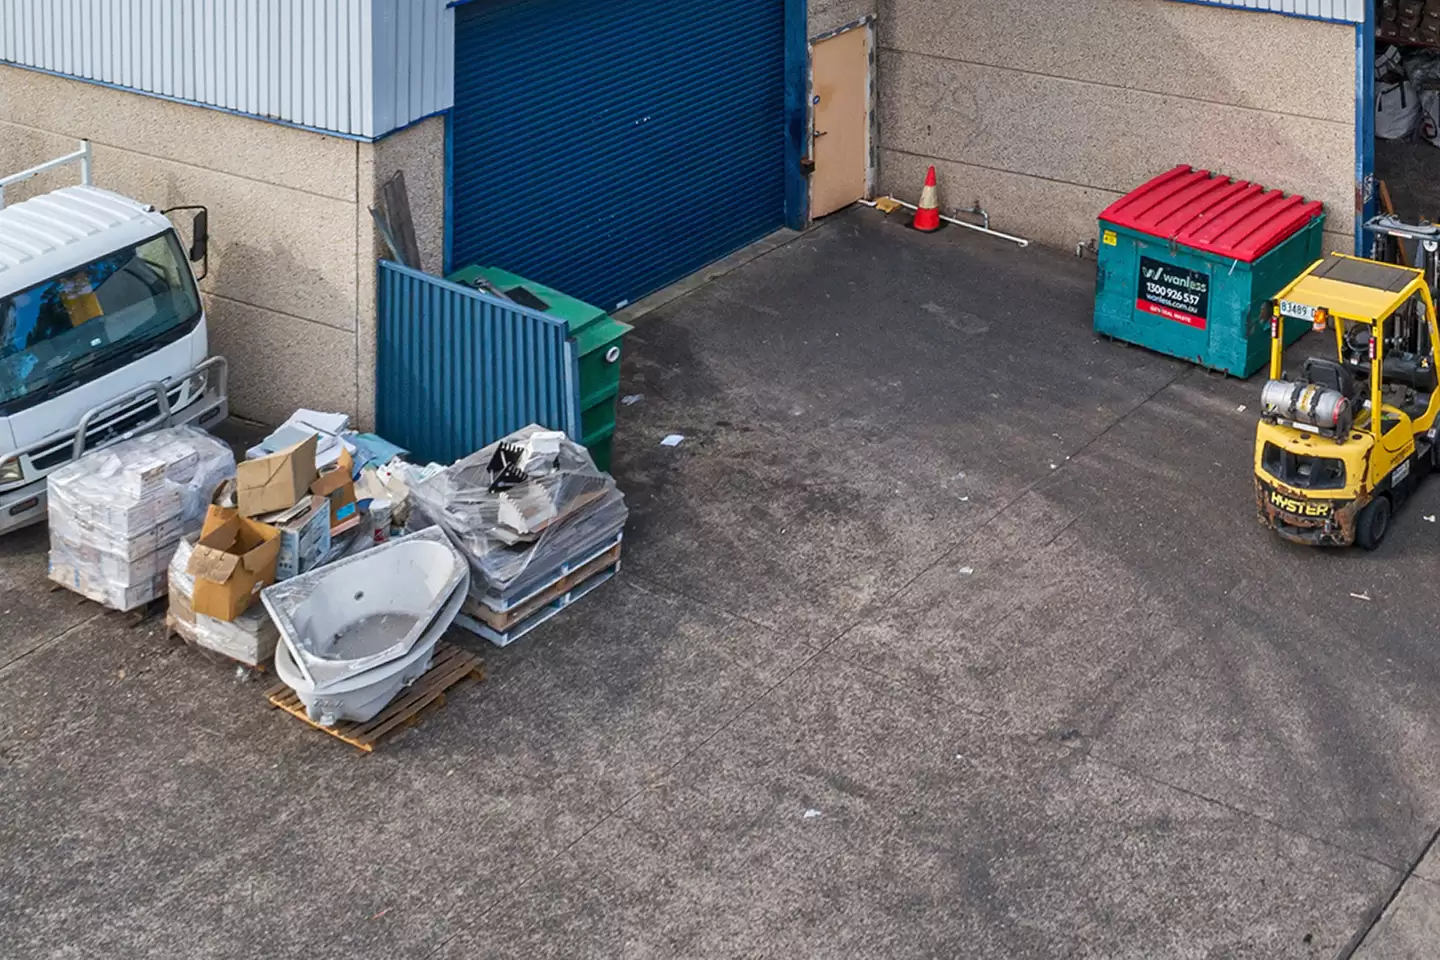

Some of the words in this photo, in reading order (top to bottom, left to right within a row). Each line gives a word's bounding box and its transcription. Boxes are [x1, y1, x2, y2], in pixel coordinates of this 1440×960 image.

[1146, 281, 1166, 296] 1300
[1166, 288, 1183, 301] 926
[1163, 273, 1207, 293] wanless
[1271, 491, 1329, 516] HYSTER
